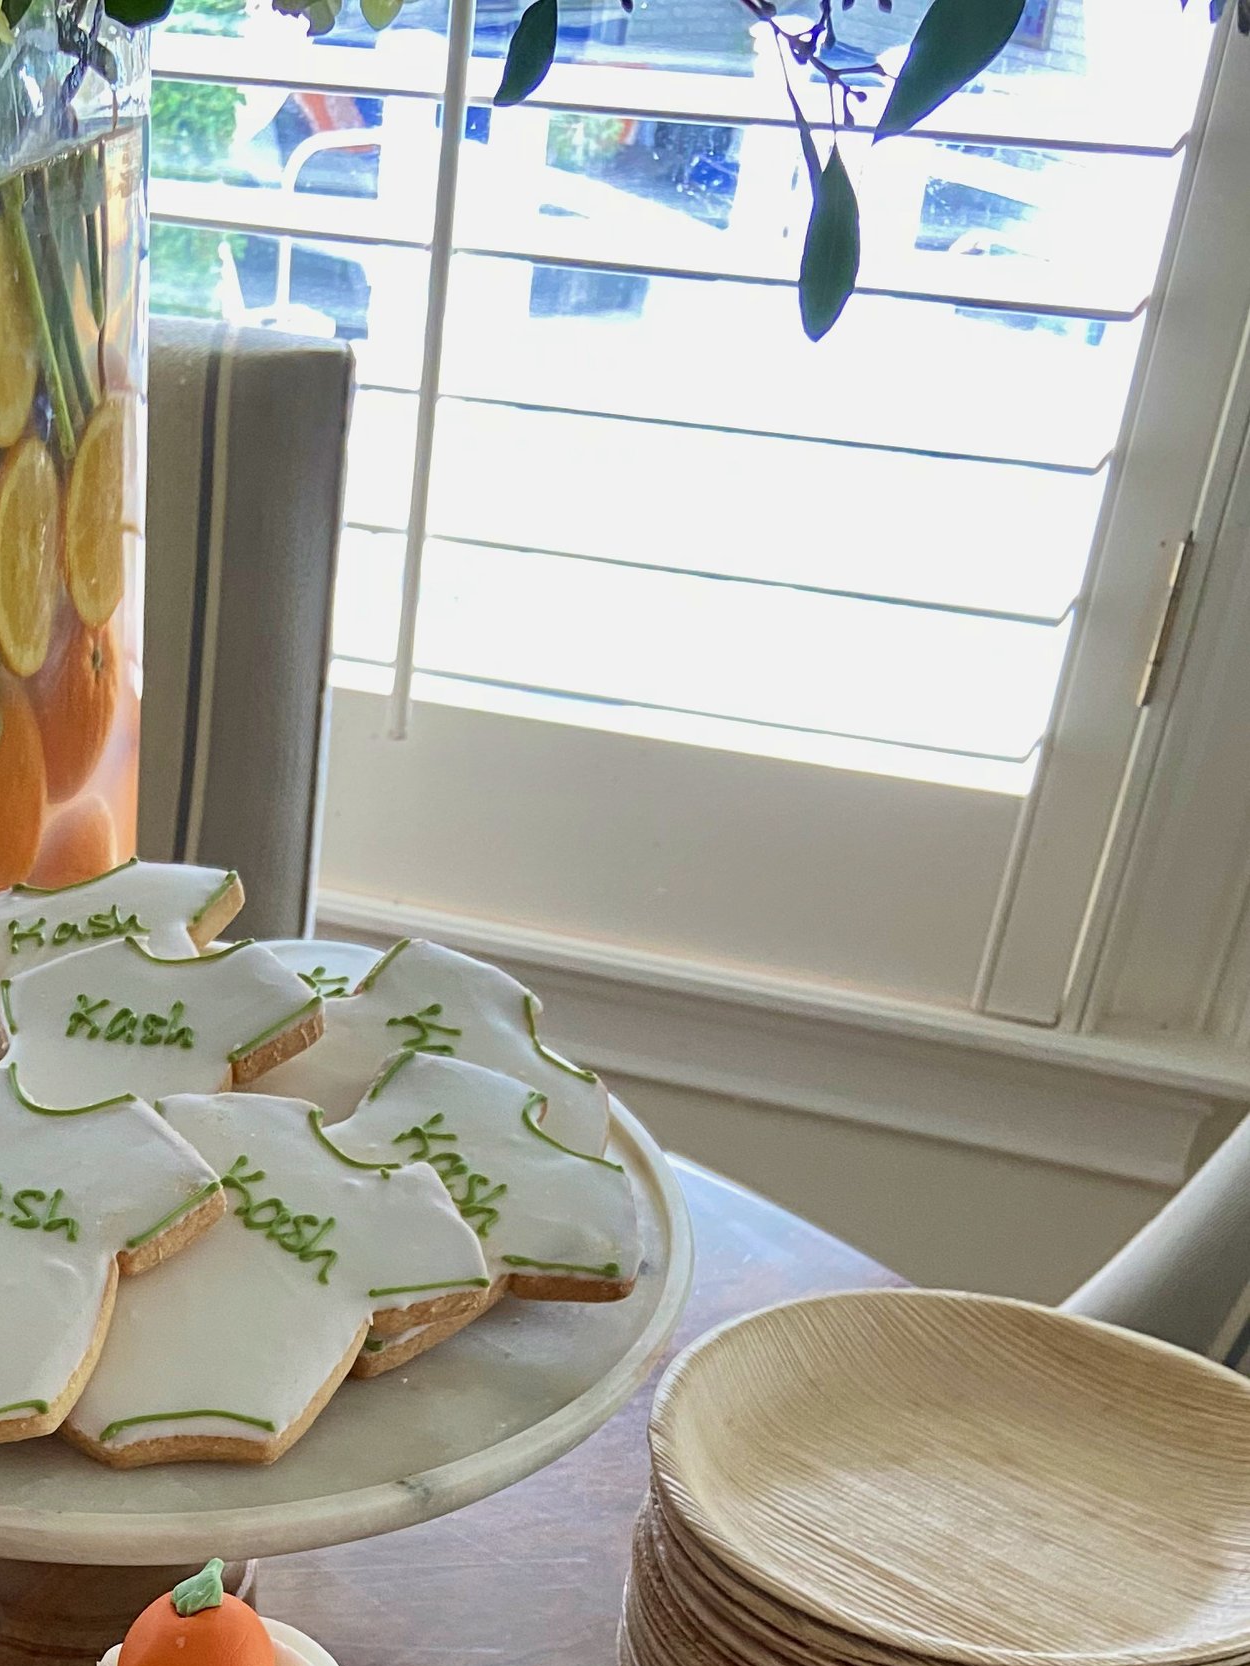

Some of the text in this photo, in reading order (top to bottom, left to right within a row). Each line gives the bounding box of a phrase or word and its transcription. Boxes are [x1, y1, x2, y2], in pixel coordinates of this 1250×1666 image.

[8, 904, 151, 954] Kash
[65, 993, 195, 1050] Kash
[218, 1154, 338, 1286] Kash
